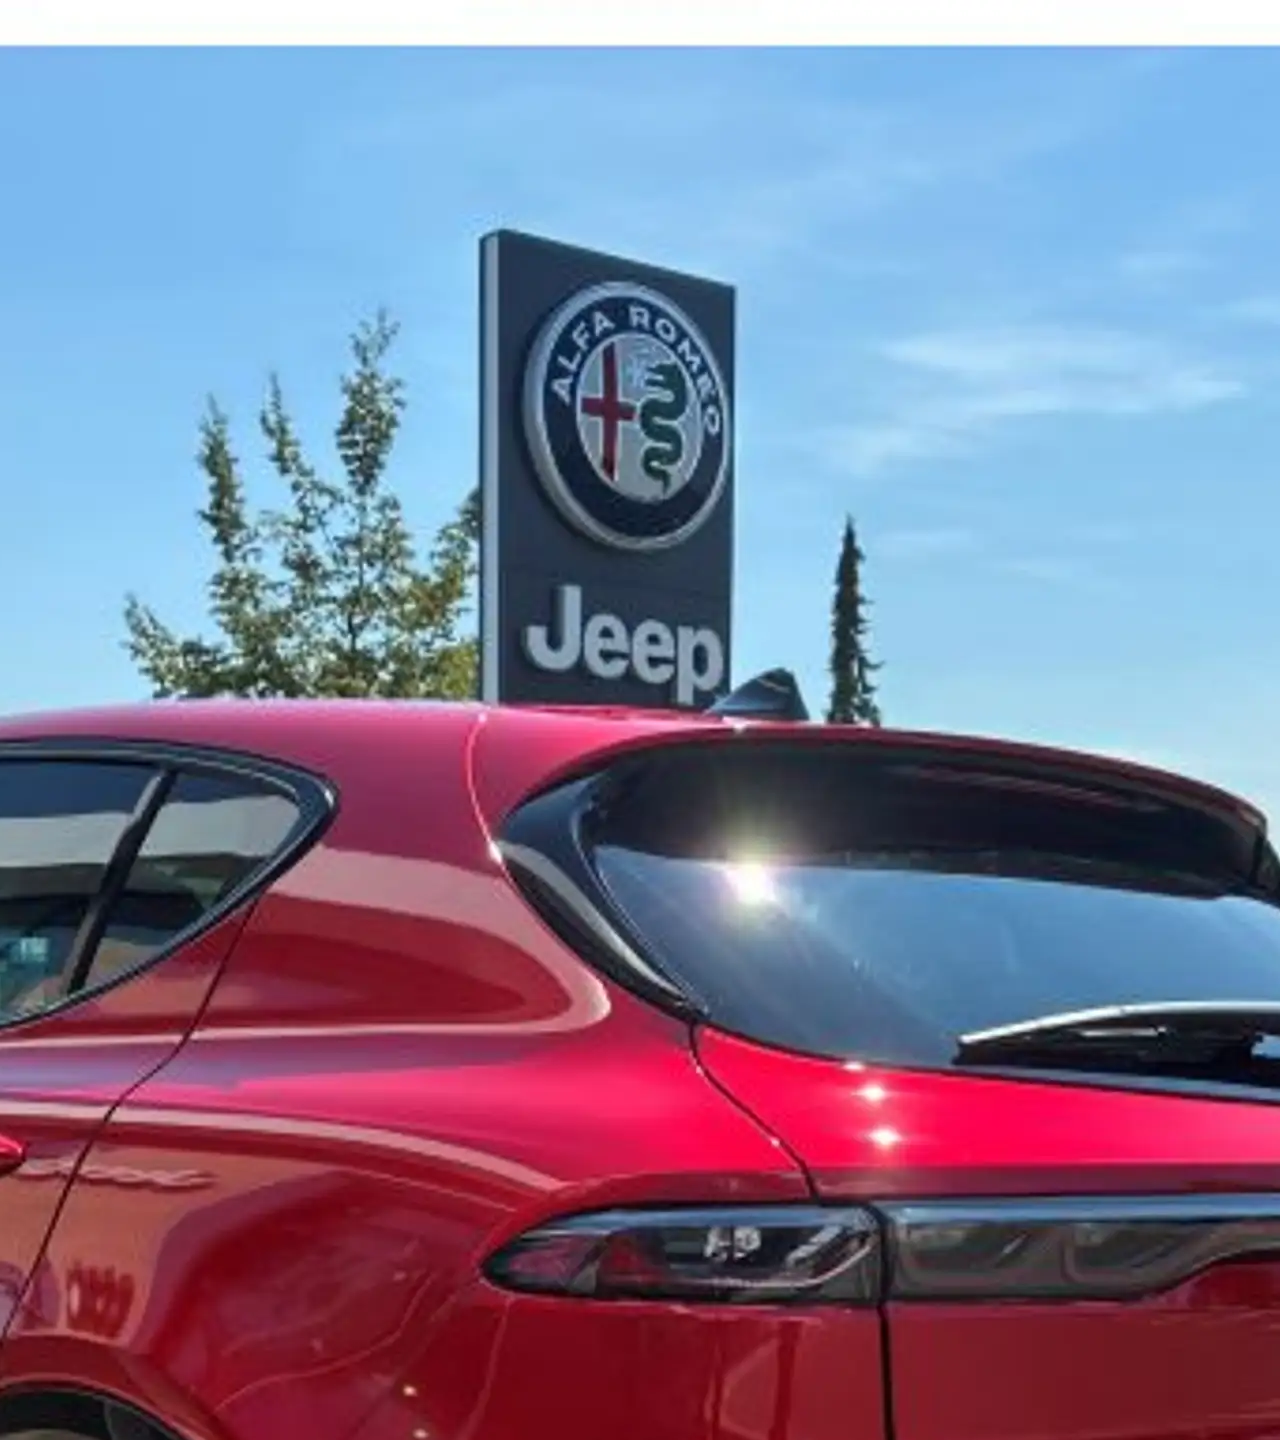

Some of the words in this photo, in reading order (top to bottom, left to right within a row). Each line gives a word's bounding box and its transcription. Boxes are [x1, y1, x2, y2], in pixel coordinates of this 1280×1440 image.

[550, 306, 616, 406] ALFA
[628, 304, 722, 437] ROMEO
[525, 583, 723, 705] Jeep
